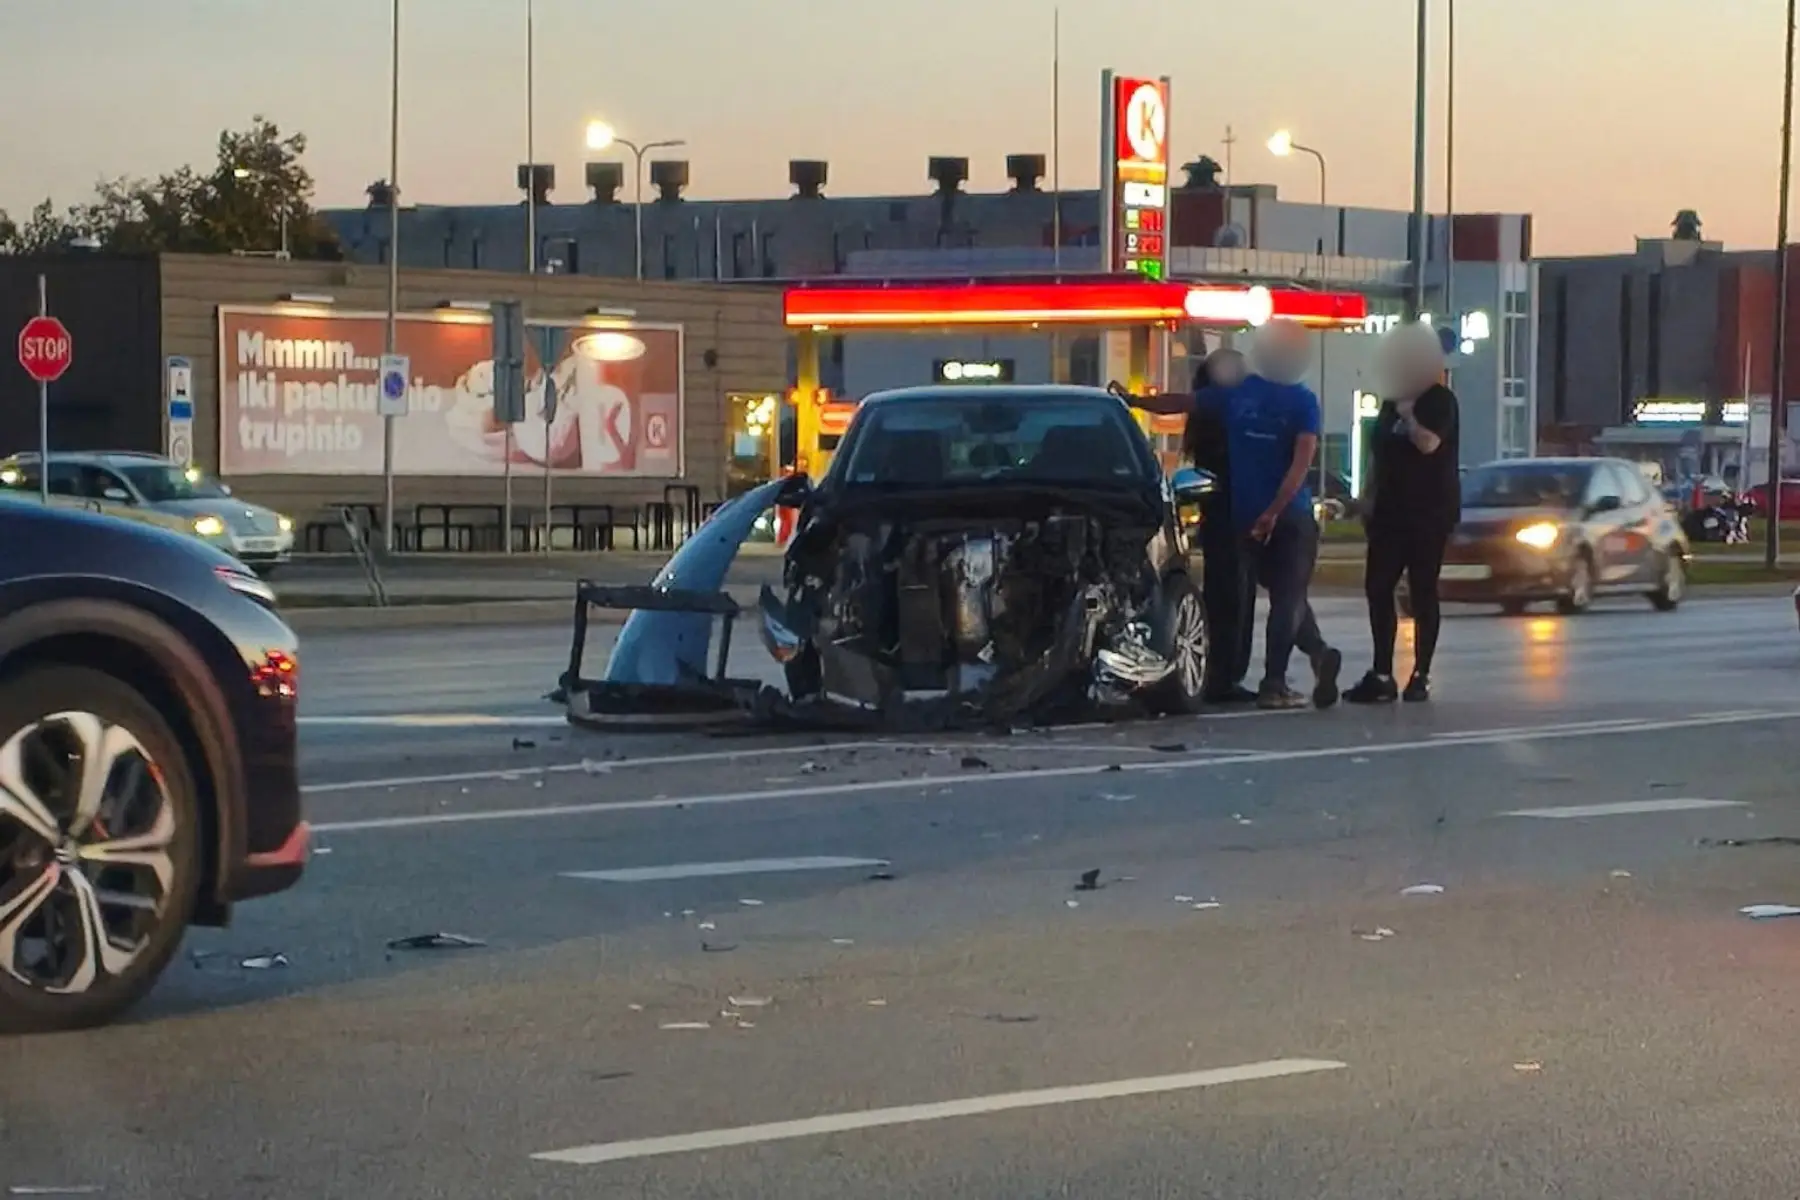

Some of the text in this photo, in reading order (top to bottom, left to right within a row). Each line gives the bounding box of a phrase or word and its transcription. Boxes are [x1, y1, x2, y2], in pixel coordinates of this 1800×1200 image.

[24, 337, 68, 361] STOP
[237, 329, 379, 370] Mmmm...
[238, 370, 442, 418] Iki paskuio
[238, 414, 363, 457] trupinio
